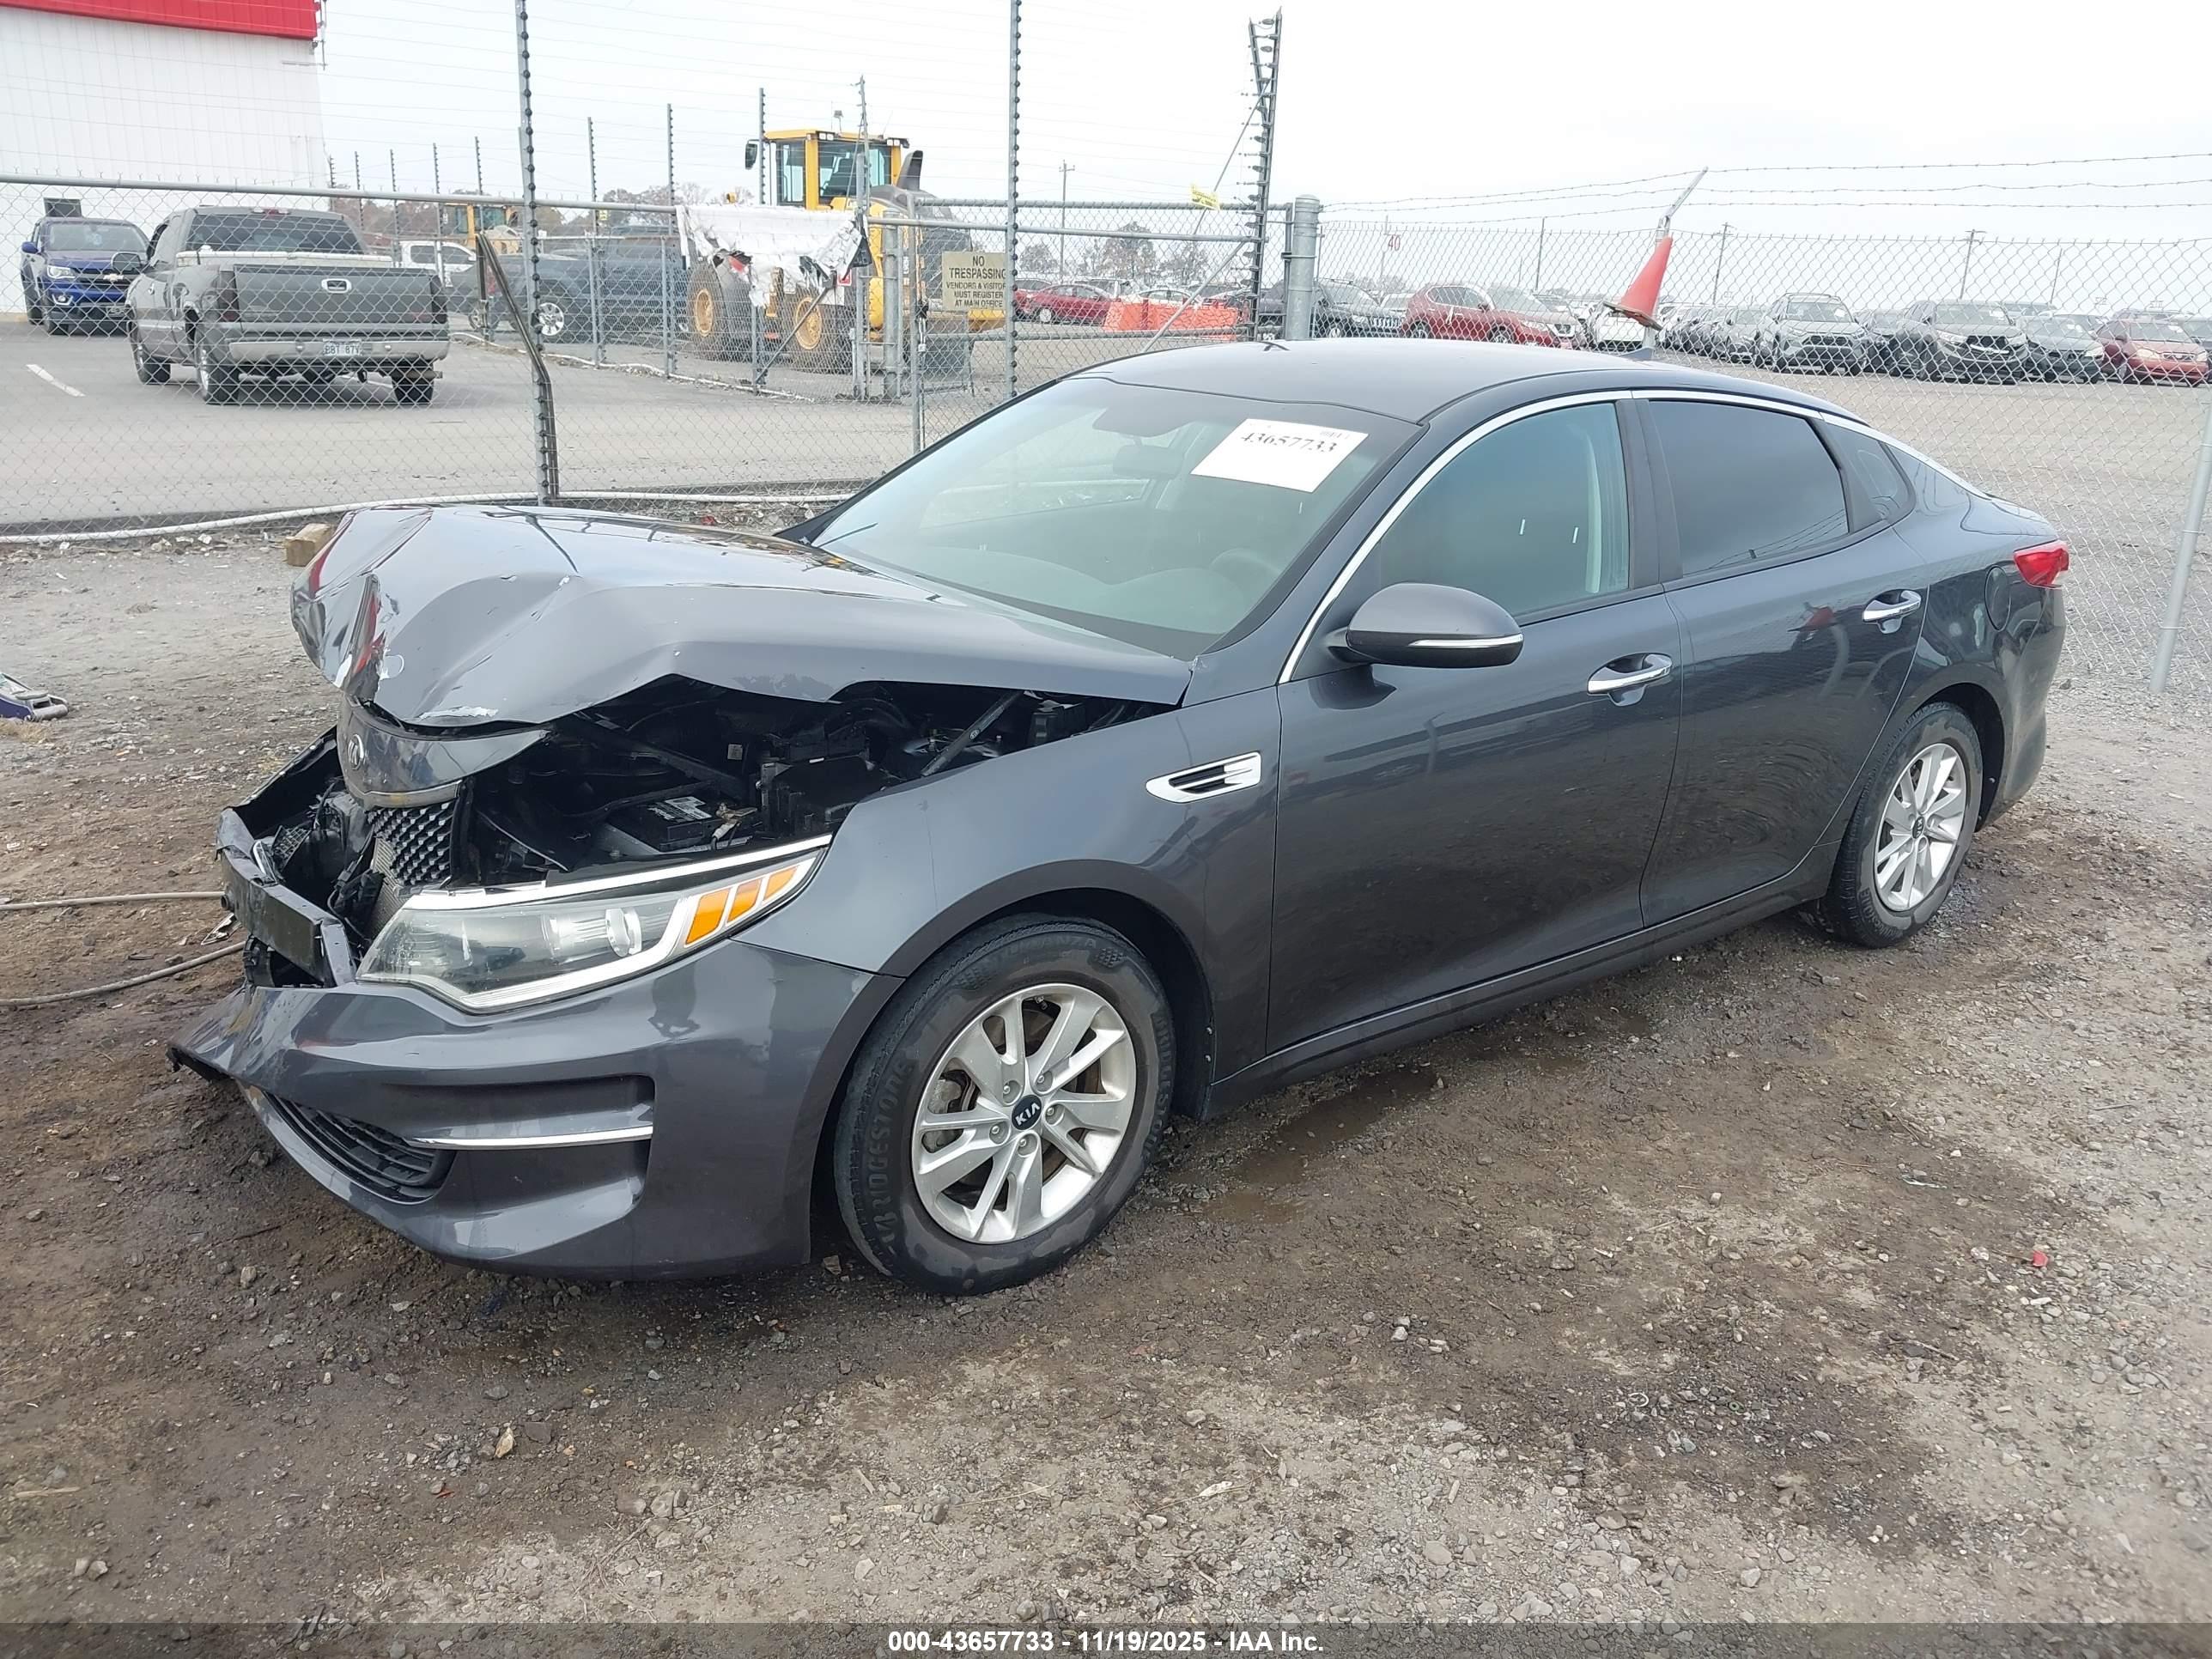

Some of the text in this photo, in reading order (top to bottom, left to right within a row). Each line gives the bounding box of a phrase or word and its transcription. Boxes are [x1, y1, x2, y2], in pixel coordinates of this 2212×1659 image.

[1388, 234, 1401, 252] 40
[972, 256, 985, 267] NO
[946, 282, 976, 290] VENDORS
[1240, 432, 1338, 453] 43657733
[1015, 1102, 1040, 1126] KIA
